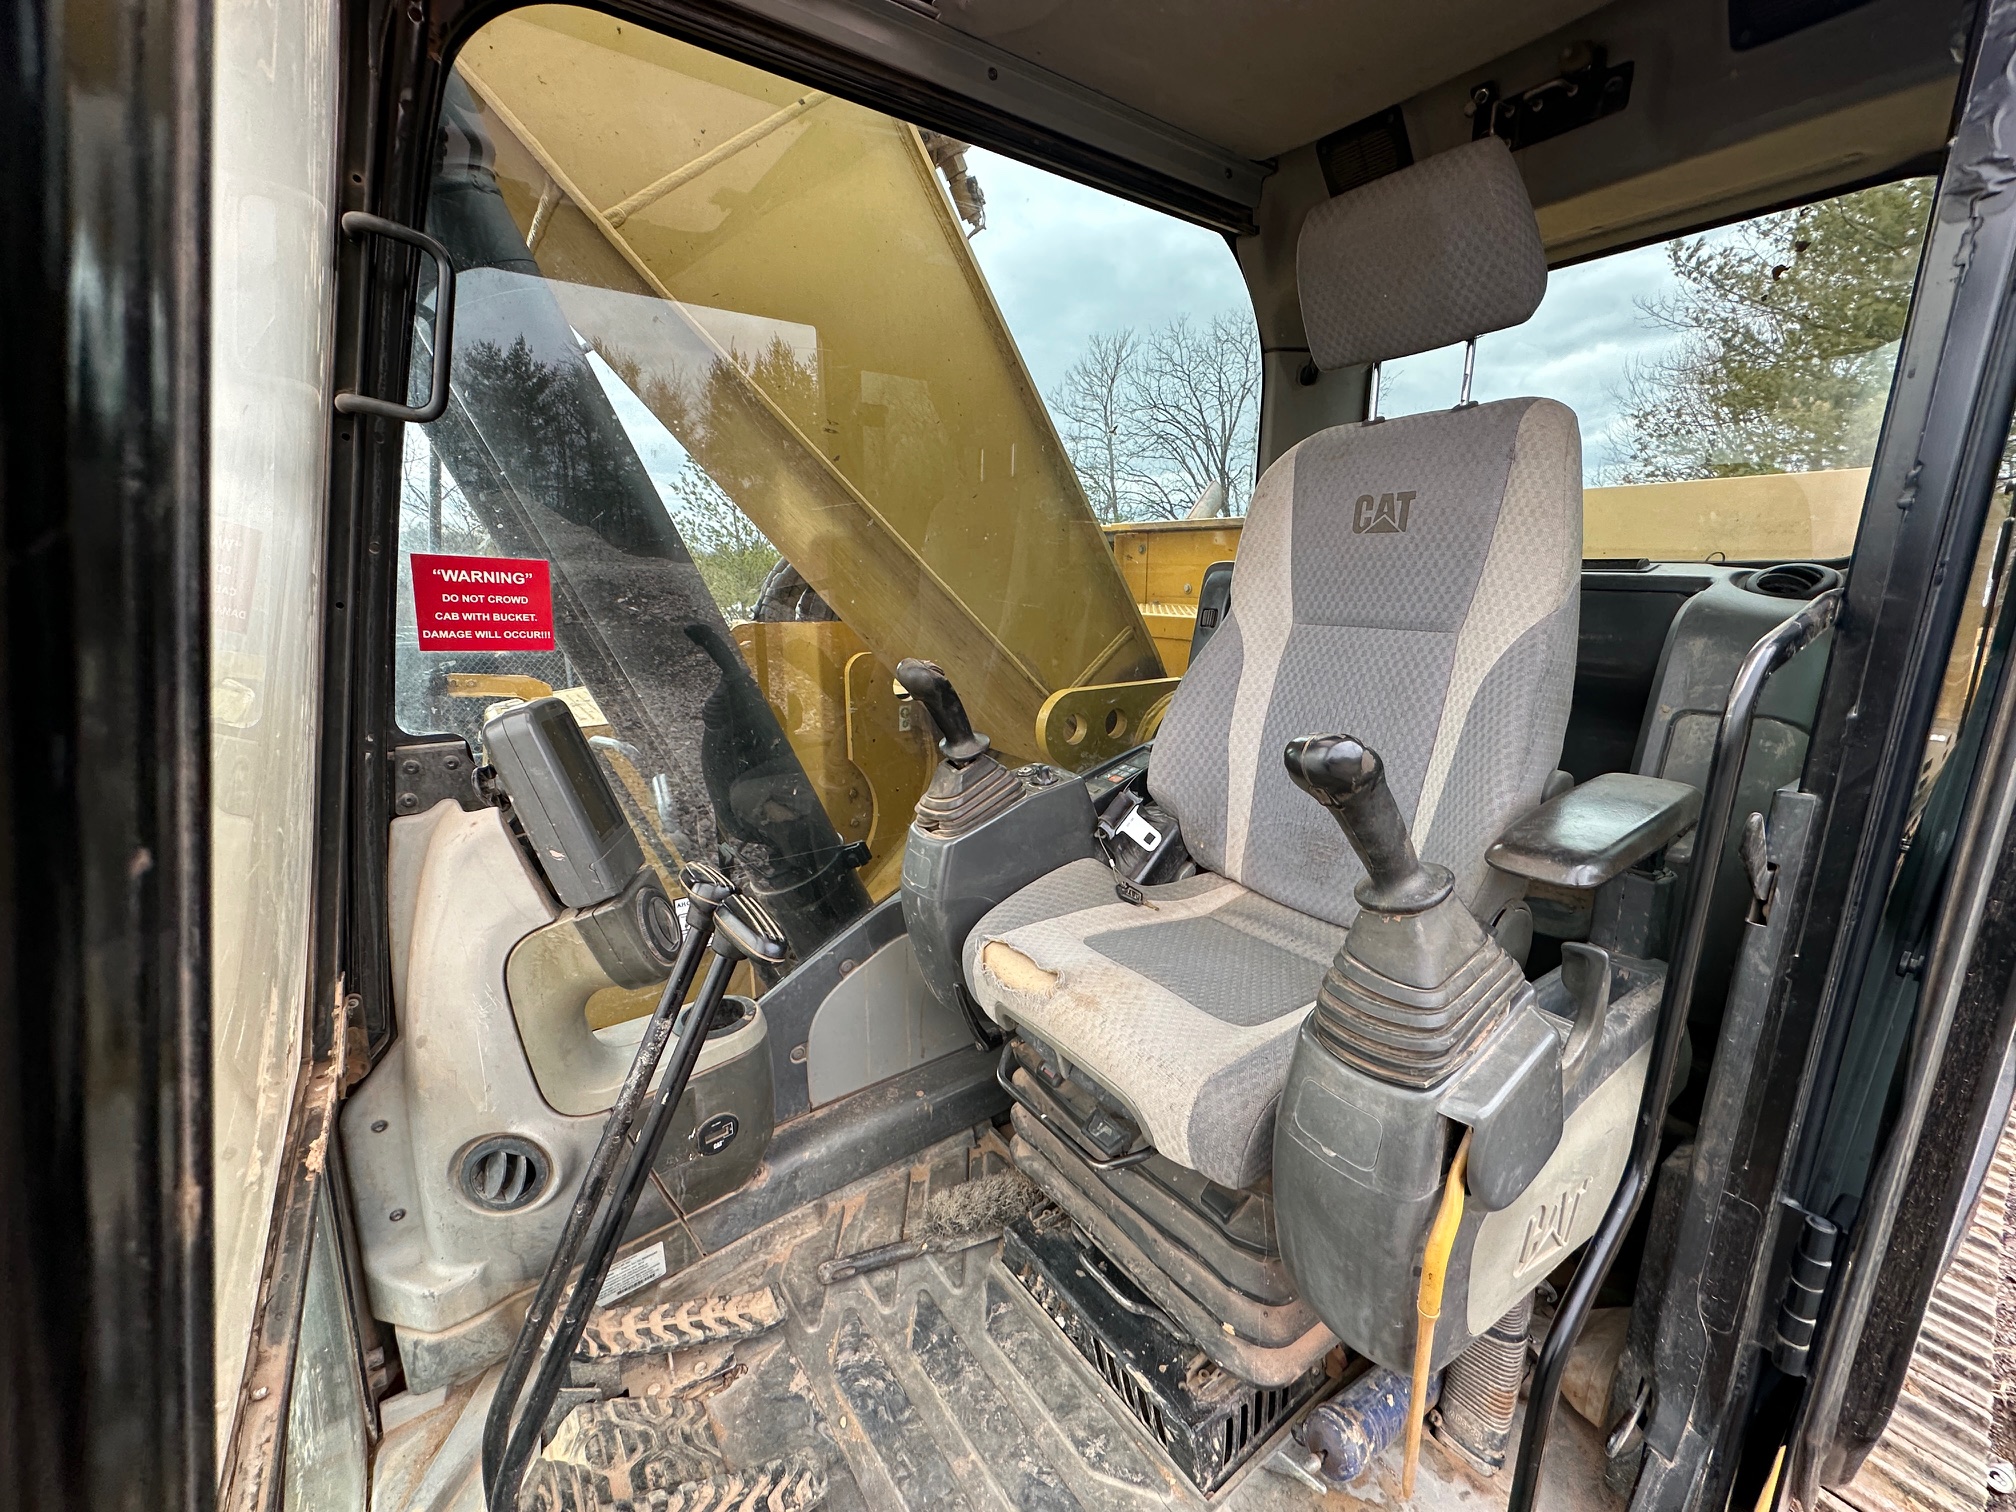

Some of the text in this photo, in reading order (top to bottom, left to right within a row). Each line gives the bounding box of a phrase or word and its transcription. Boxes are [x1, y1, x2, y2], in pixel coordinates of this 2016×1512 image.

[1353, 491, 1416, 534] CAT
[442, 593, 529, 604] DO NOT CROWD
[435, 612, 538, 622] CAB WITH BUCKET.
[422, 630, 551, 639] DAMAGE WILL OCCUR!!!
[1513, 1177, 1593, 1278] CAT
